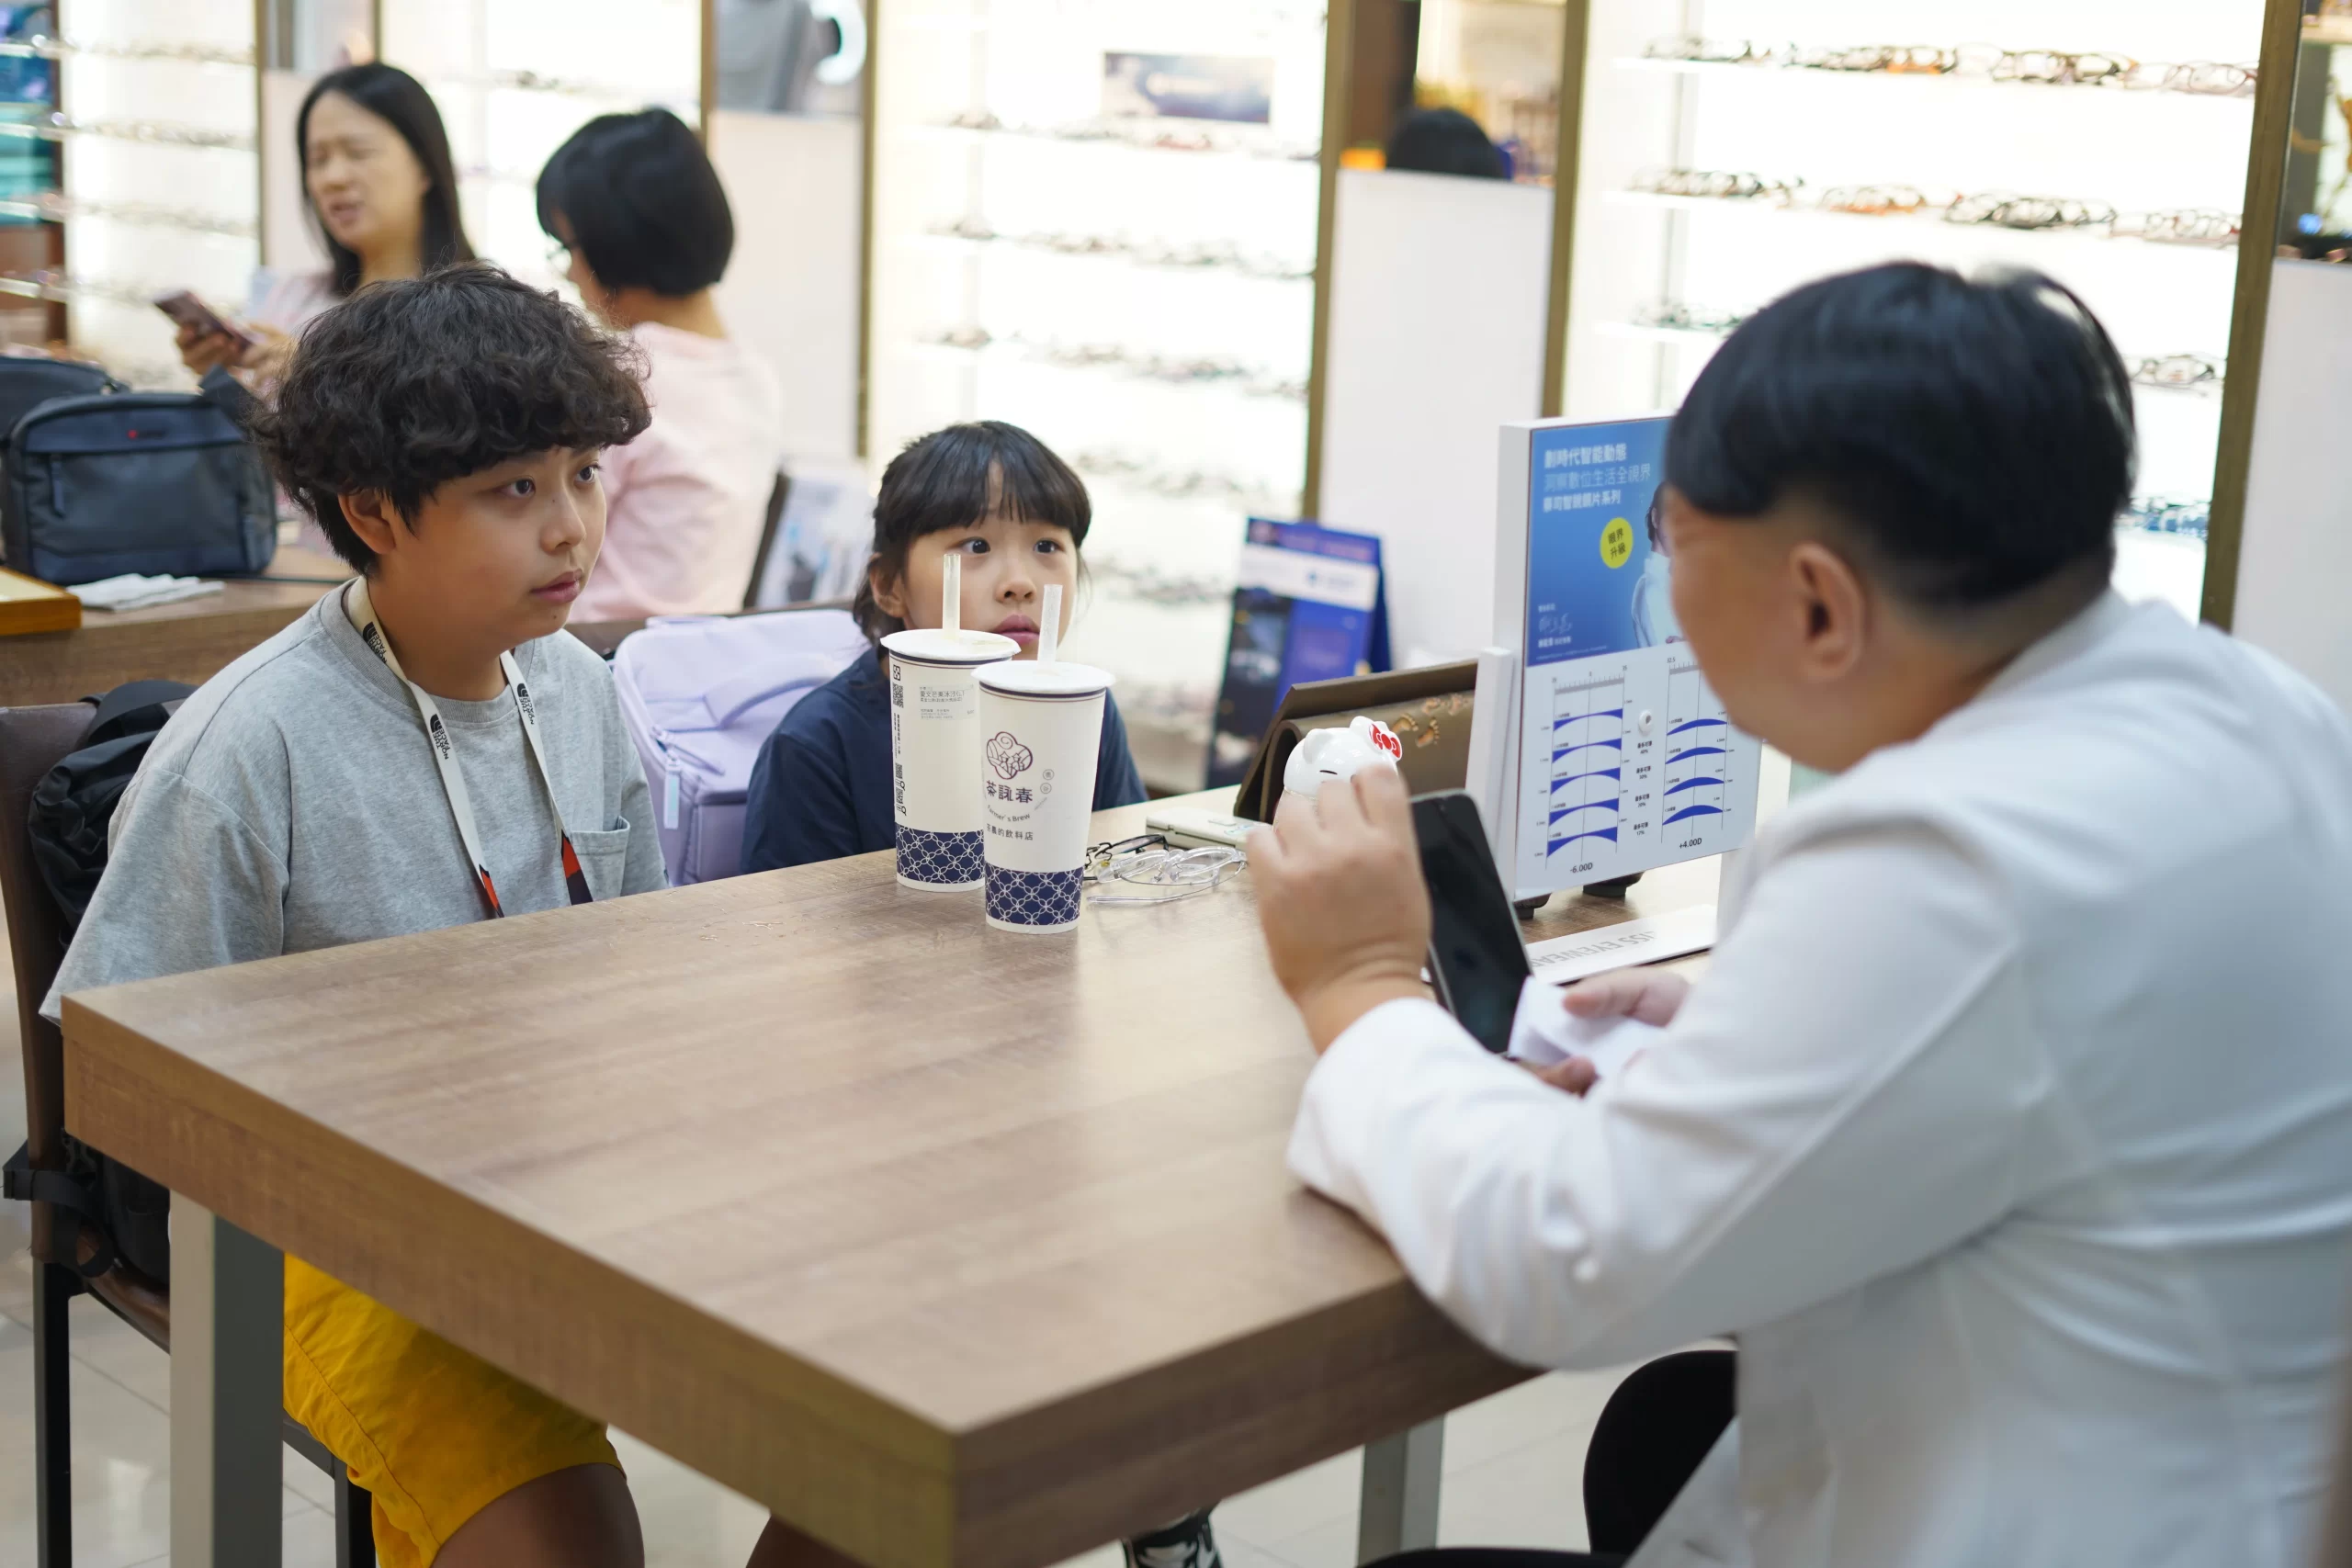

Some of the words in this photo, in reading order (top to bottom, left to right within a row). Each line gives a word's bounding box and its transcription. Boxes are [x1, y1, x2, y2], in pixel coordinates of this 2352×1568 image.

[432, 733, 441, 750] THE
[435, 731, 449, 761] NORTH
[439, 728, 451, 750] FACE
[986, 780, 1033, 804] 茶詠春
[1012, 813, 1031, 822] Brew
[1679, 838, 1702, 849] +4.00D
[1569, 863, 1593, 874] -6.00D
